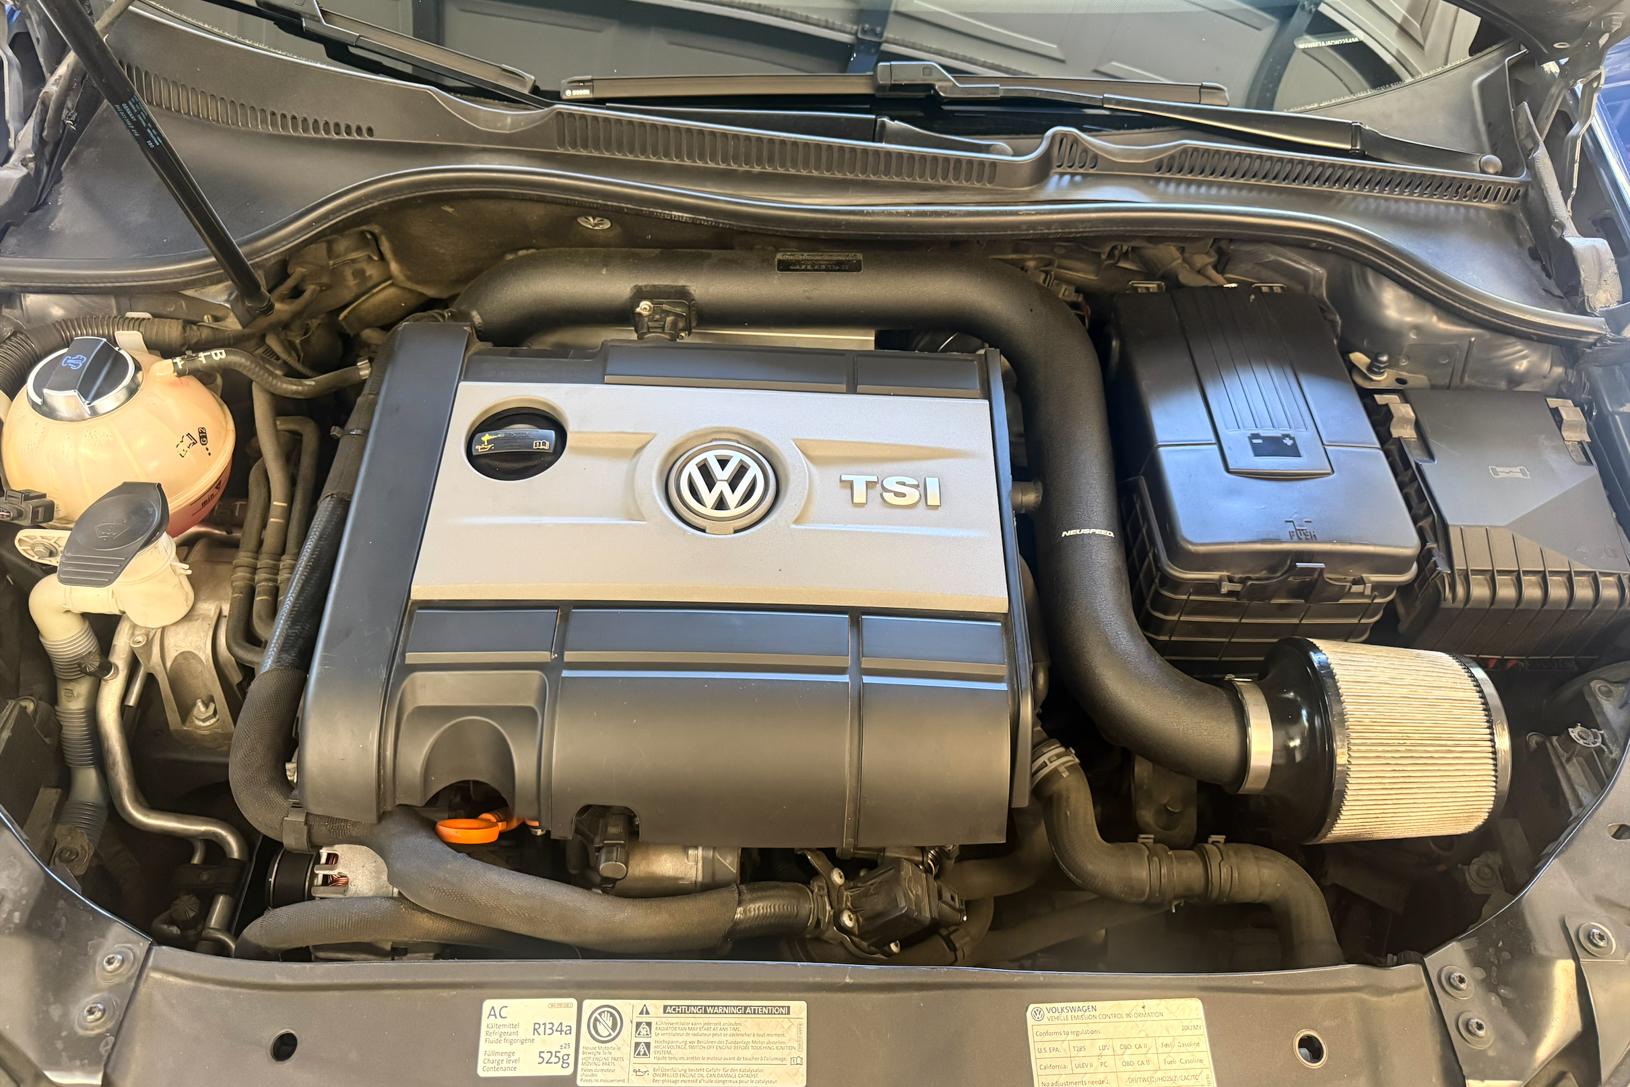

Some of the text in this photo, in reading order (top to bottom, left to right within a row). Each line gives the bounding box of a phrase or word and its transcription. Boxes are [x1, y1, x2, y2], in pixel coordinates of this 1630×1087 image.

[839, 474, 942, 508] TSI
[1061, 528, 1115, 537] NEUSPEED
[486, 1005, 509, 1020] AC
[665, 1005, 789, 1015] ACHTUNG! WARNING! ATTENTION!
[1045, 1005, 1097, 1014] VOLKSWAGEN
[532, 1022, 573, 1036] R134a
[537, 1050, 571, 1069] 525g
